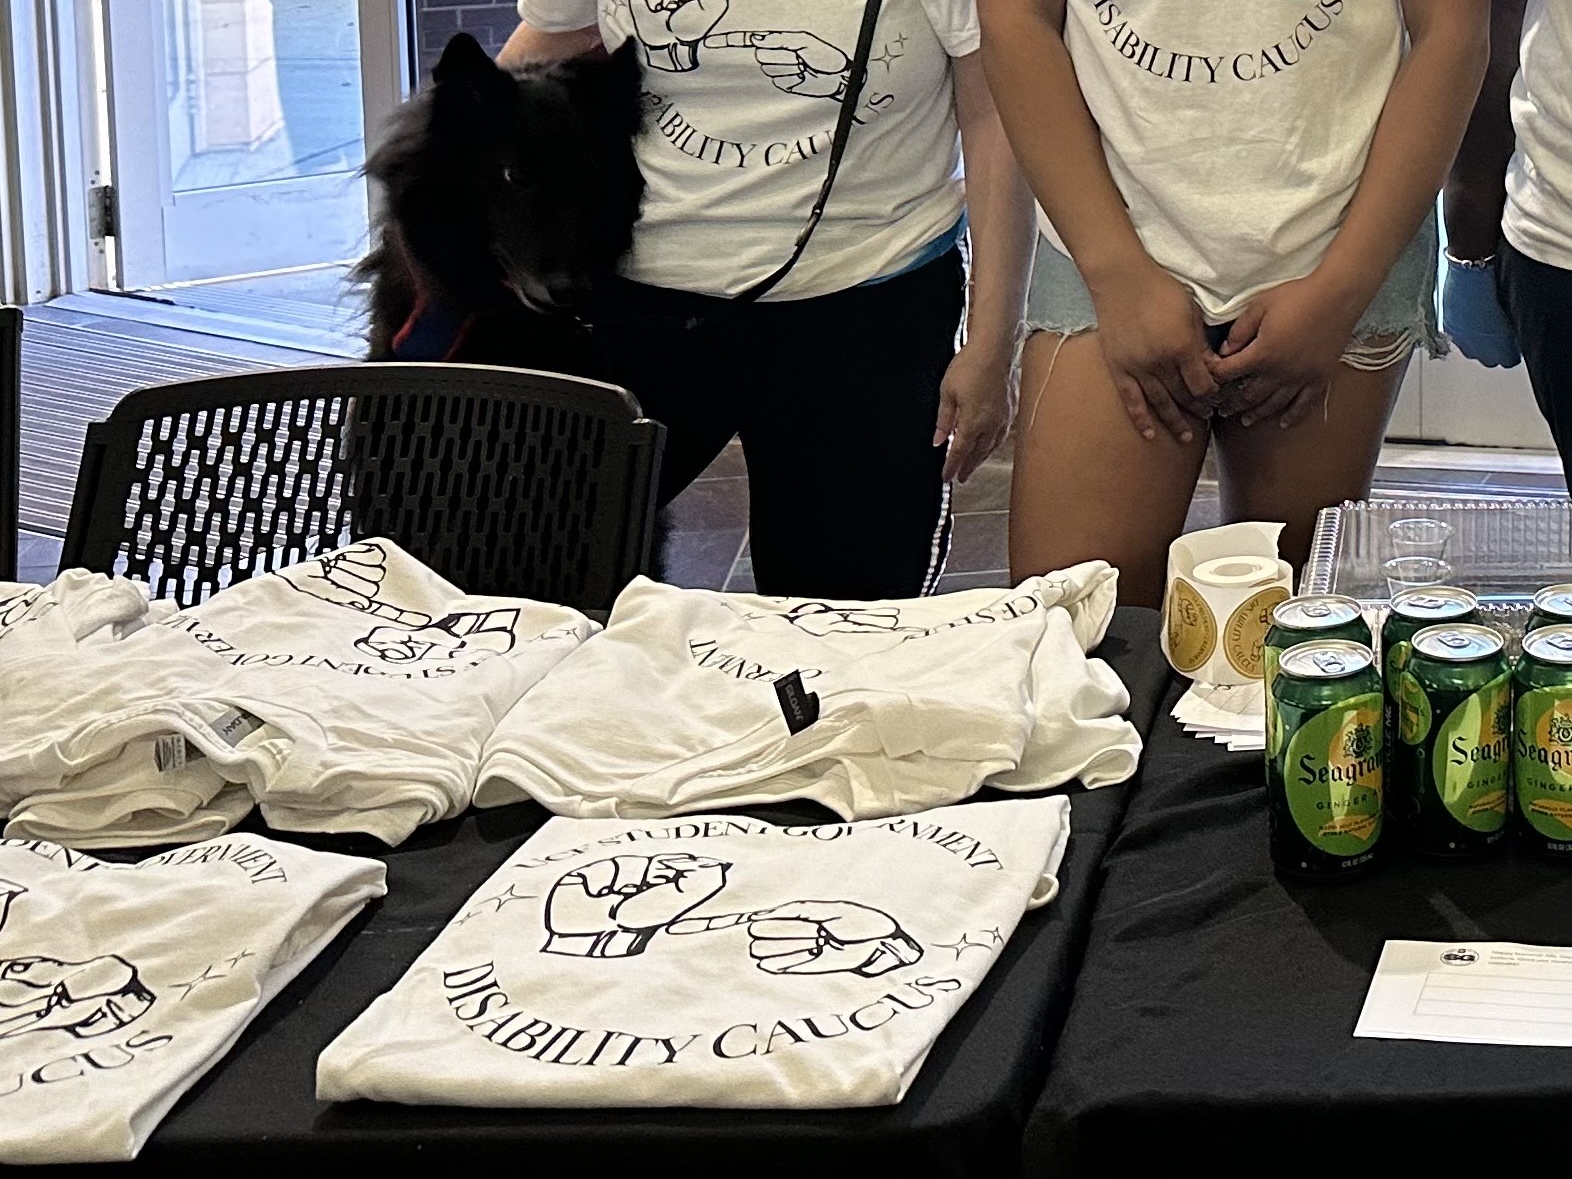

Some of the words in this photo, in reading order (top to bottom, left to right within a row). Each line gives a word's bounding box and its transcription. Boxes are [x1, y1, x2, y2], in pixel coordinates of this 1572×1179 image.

[1316, 794, 1369, 810] GINGER
[442, 960, 702, 1068] DISABILITY
[711, 975, 962, 1059] CAUCUS
